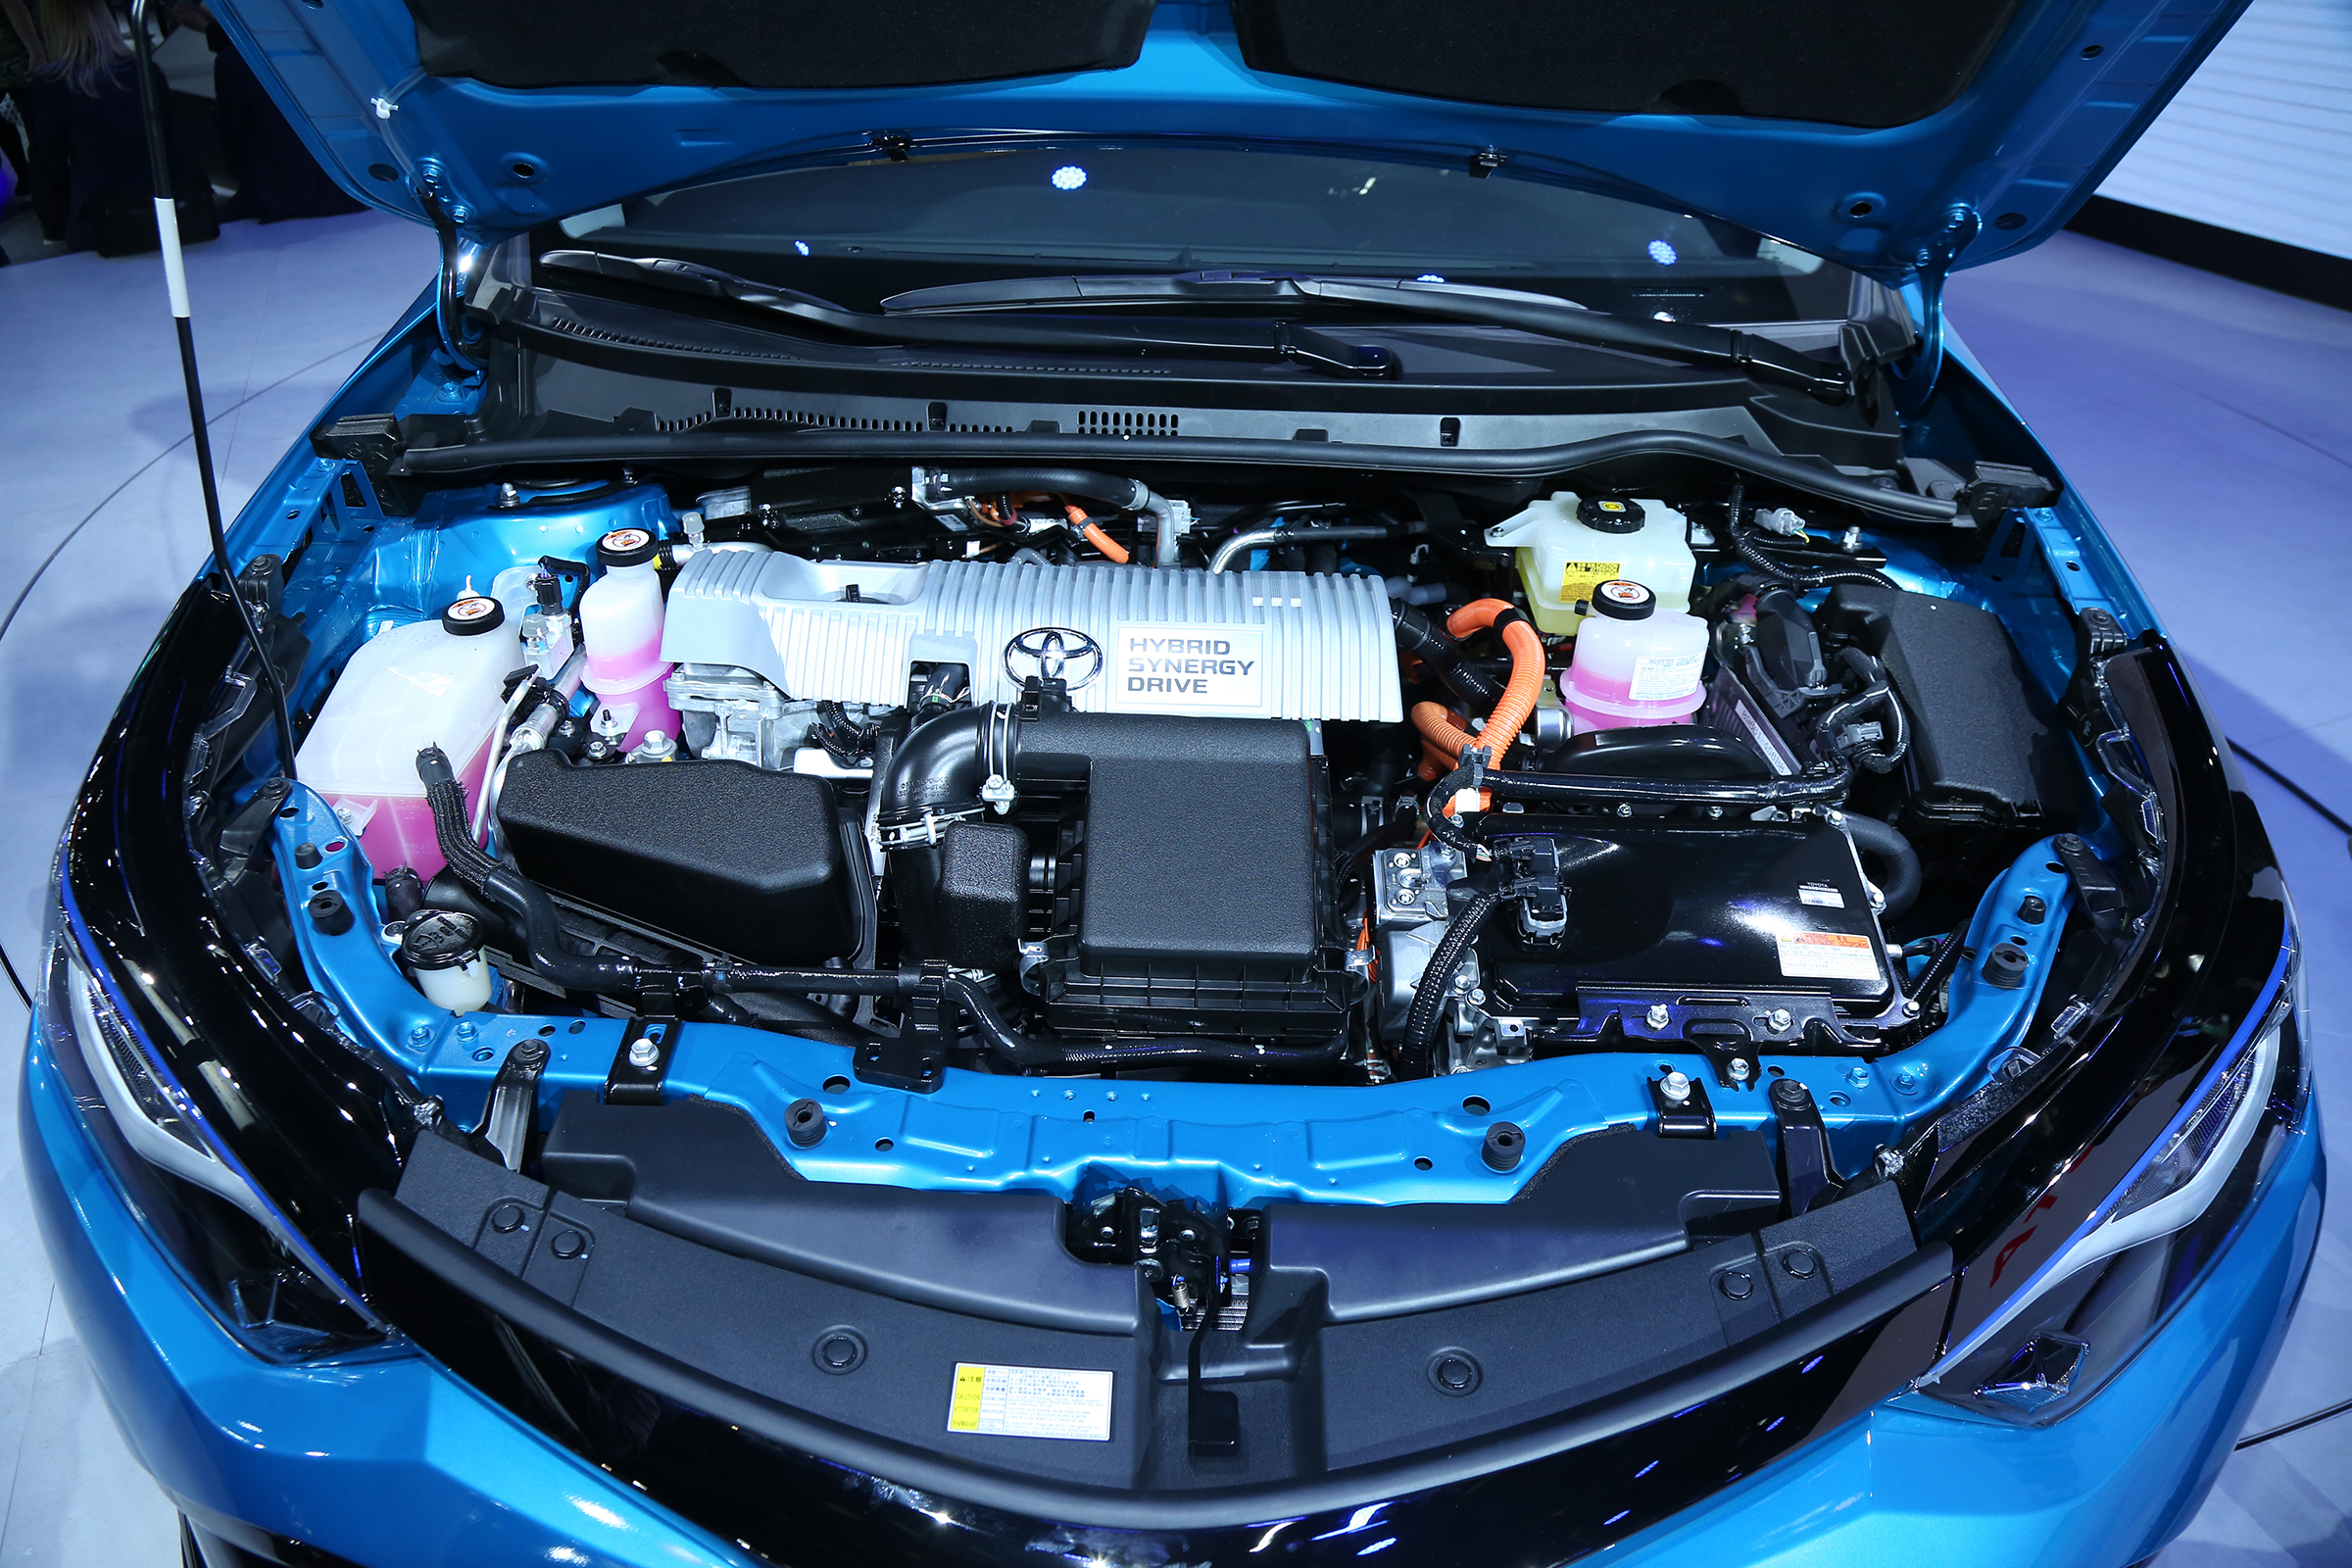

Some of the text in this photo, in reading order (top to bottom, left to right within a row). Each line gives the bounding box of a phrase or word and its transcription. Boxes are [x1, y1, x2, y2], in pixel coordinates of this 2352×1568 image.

[1129, 638, 1230, 656] HYBRID
[1128, 659, 1254, 677] SYNERGY
[1127, 676, 1208, 694] DRIVE
[956, 1393, 981, 1401] CAUTION
[954, 1405, 979, 1414] ATTENTION
